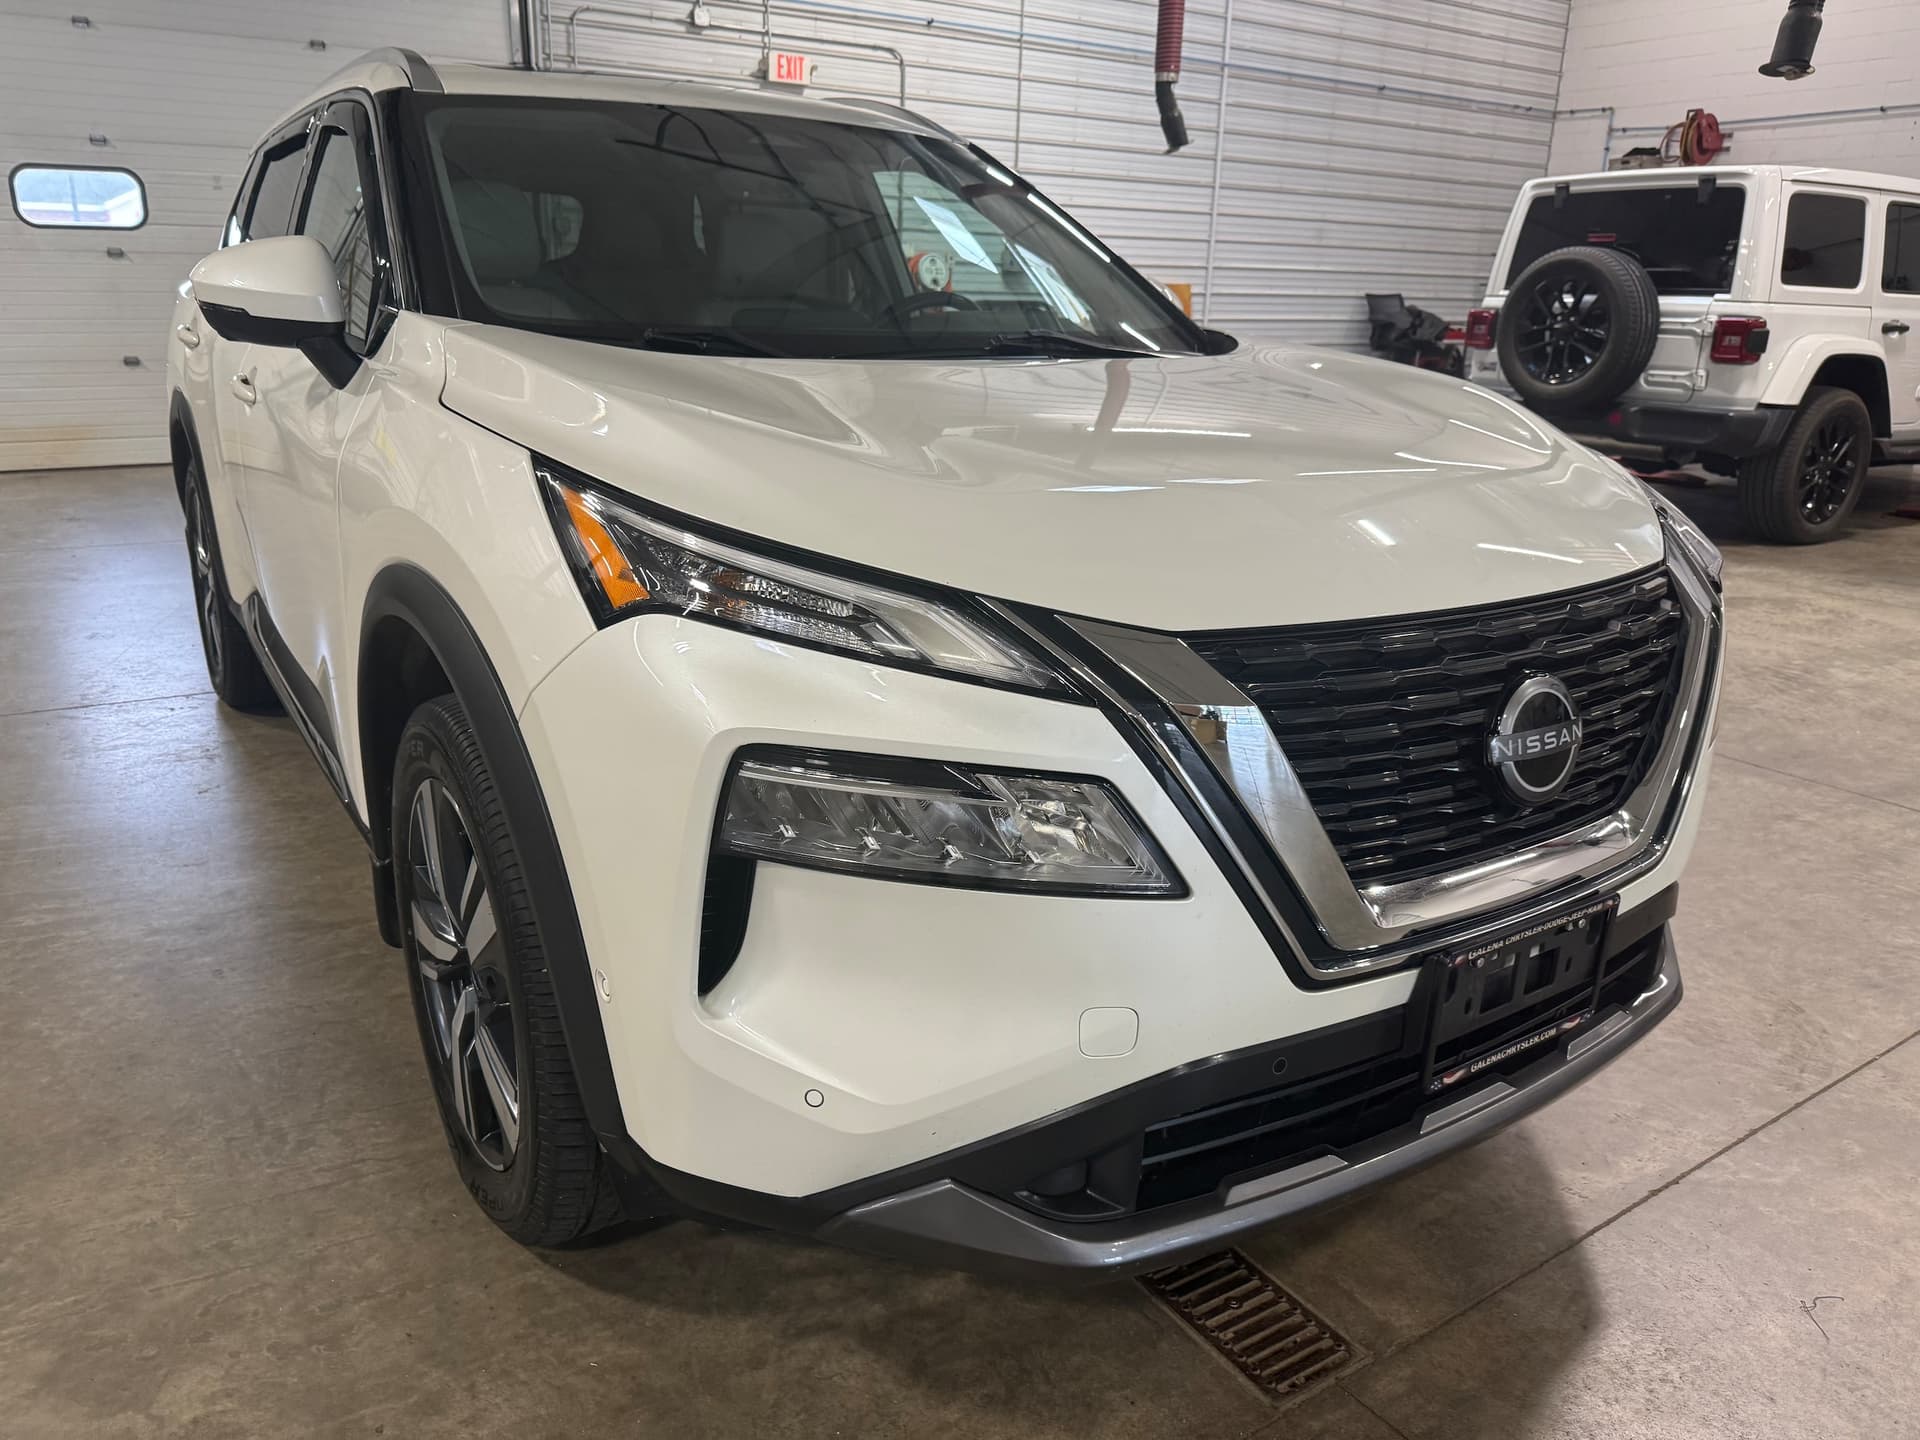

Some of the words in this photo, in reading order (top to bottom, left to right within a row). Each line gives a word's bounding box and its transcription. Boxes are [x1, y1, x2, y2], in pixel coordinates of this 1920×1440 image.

[776, 53, 805, 81] EXIT
[1491, 723, 1582, 760] NISSAN
[1468, 940, 1504, 960] GALENA
[1470, 1027, 1557, 1073] GALENACHRYSLER.COM
